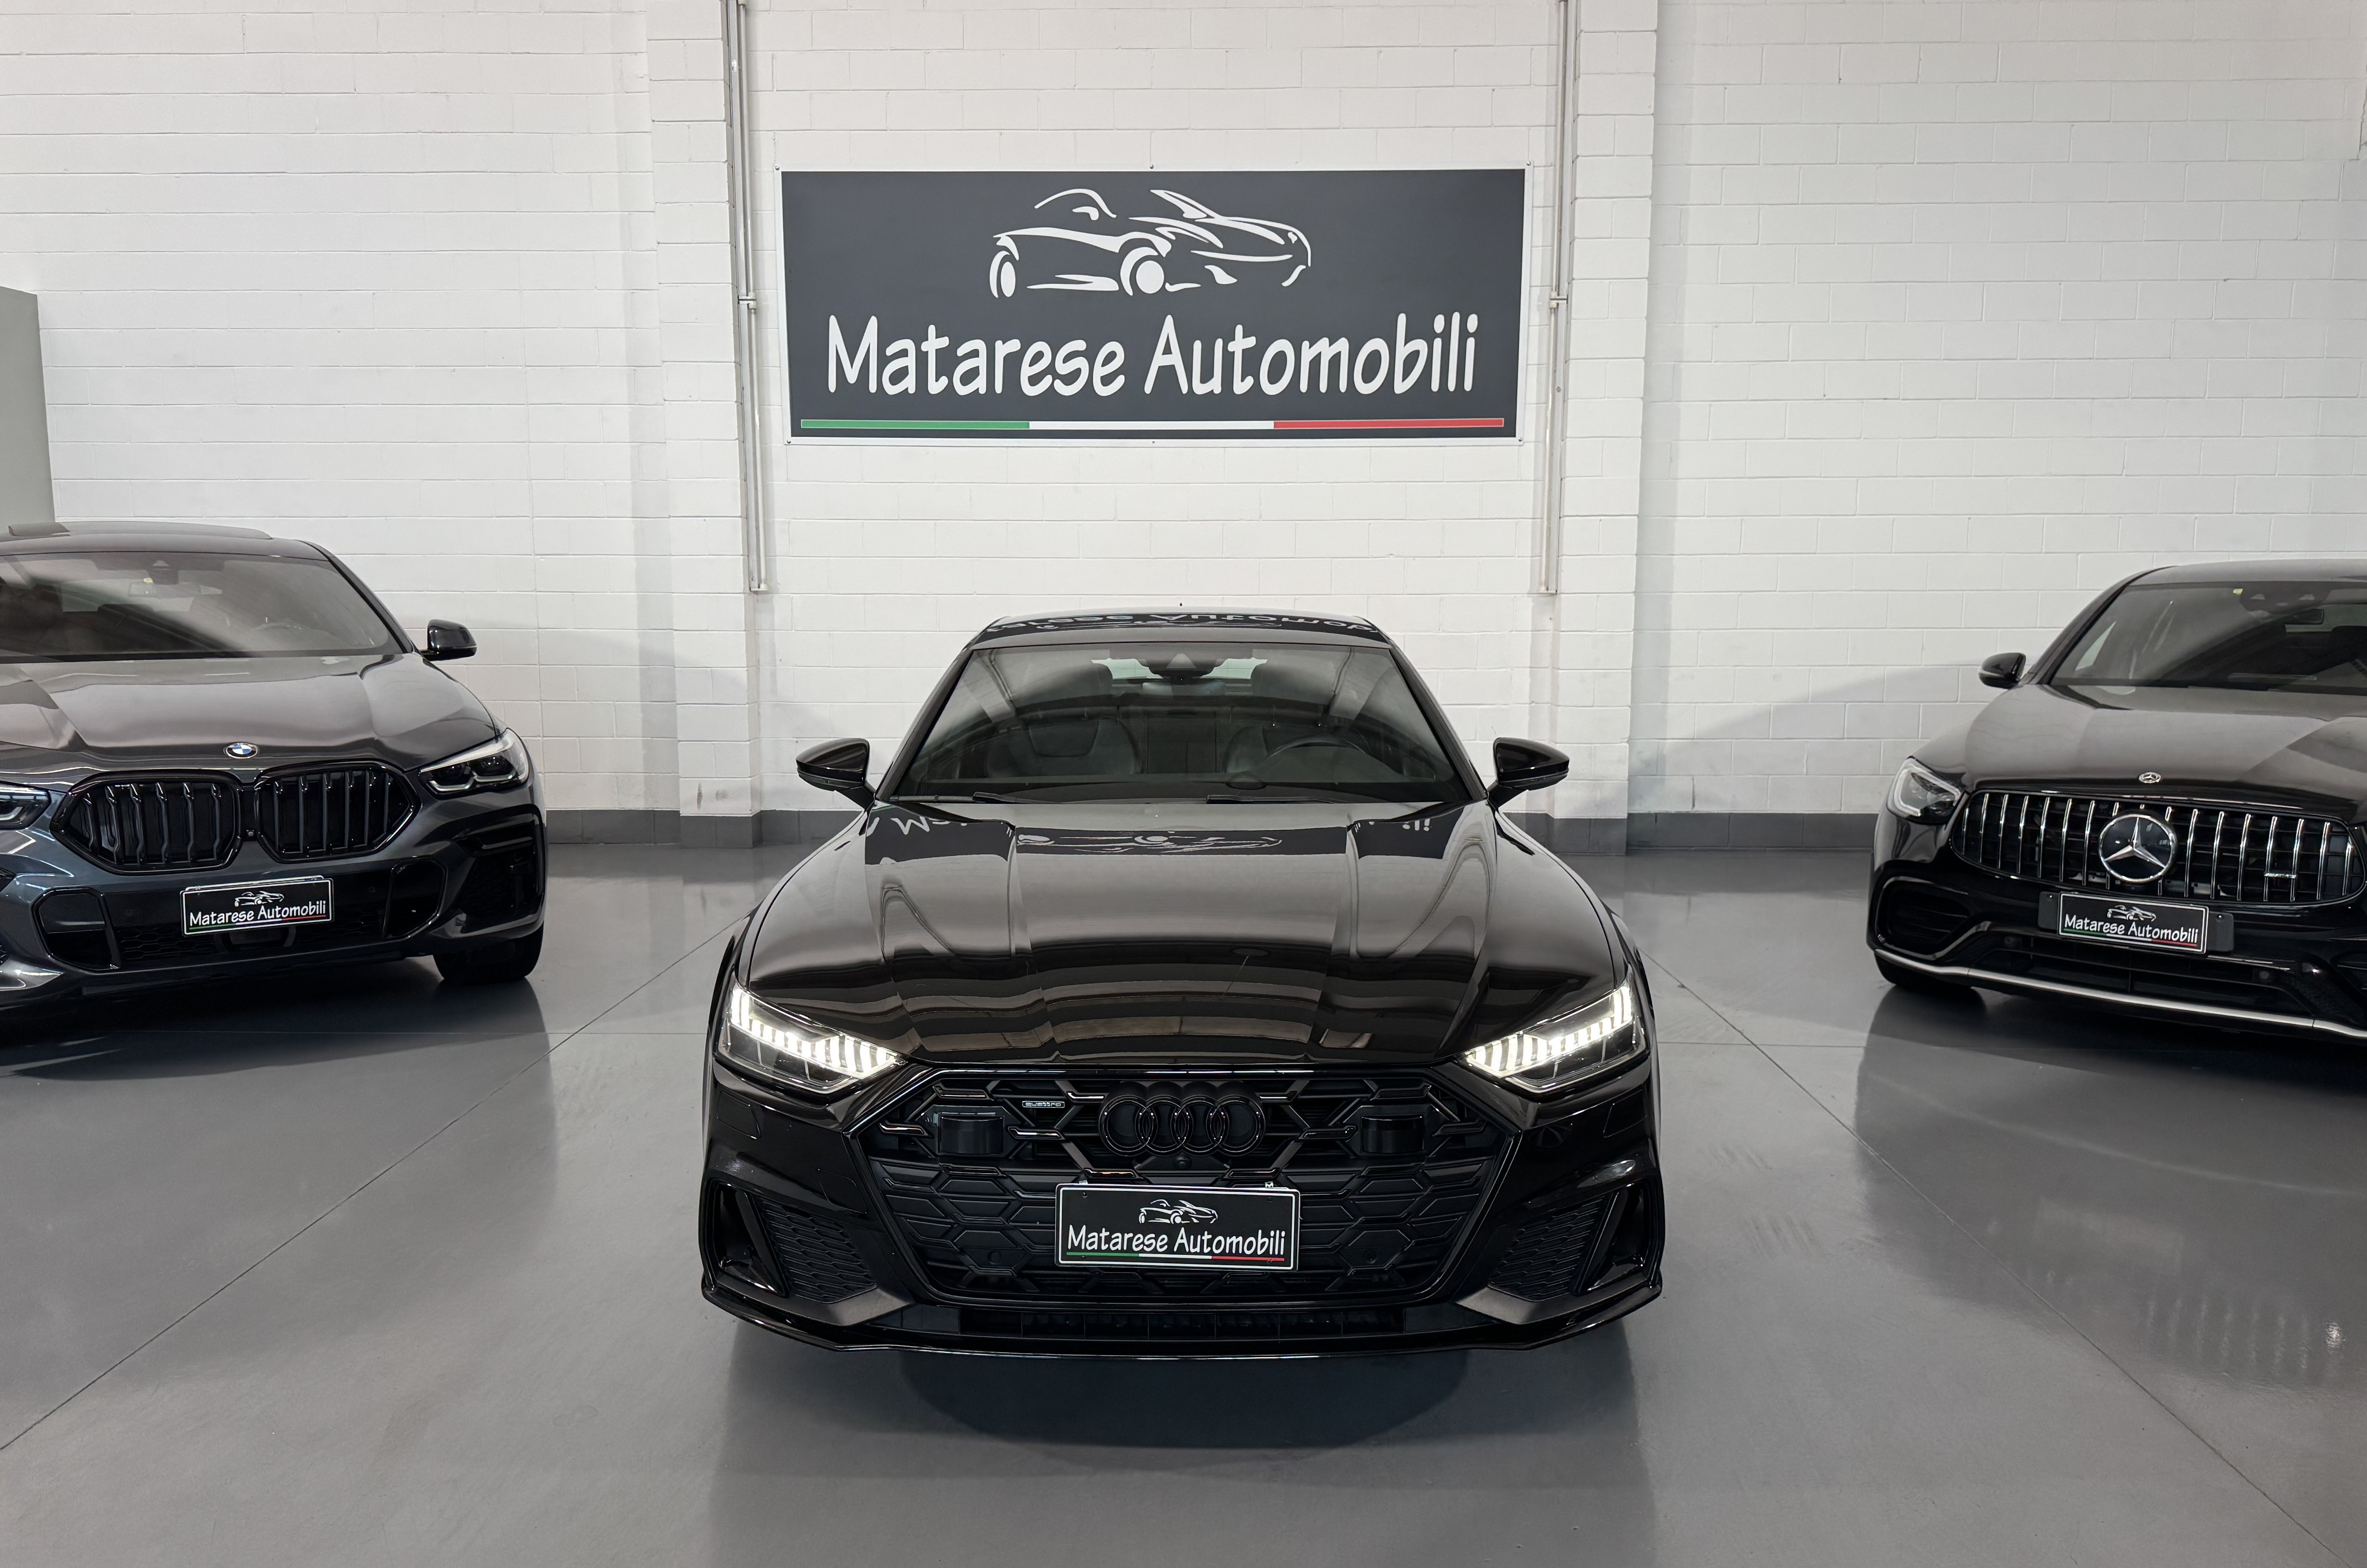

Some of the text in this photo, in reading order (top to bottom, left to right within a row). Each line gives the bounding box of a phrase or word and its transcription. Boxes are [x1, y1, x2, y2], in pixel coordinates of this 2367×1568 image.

[828, 312, 1478, 396] Matarese Automobili
[190, 900, 326, 926] Matarese Automobili
[2064, 914, 2198, 943] Matarese Automobili
[1067, 1225, 1285, 1256] Matarese Automobili
